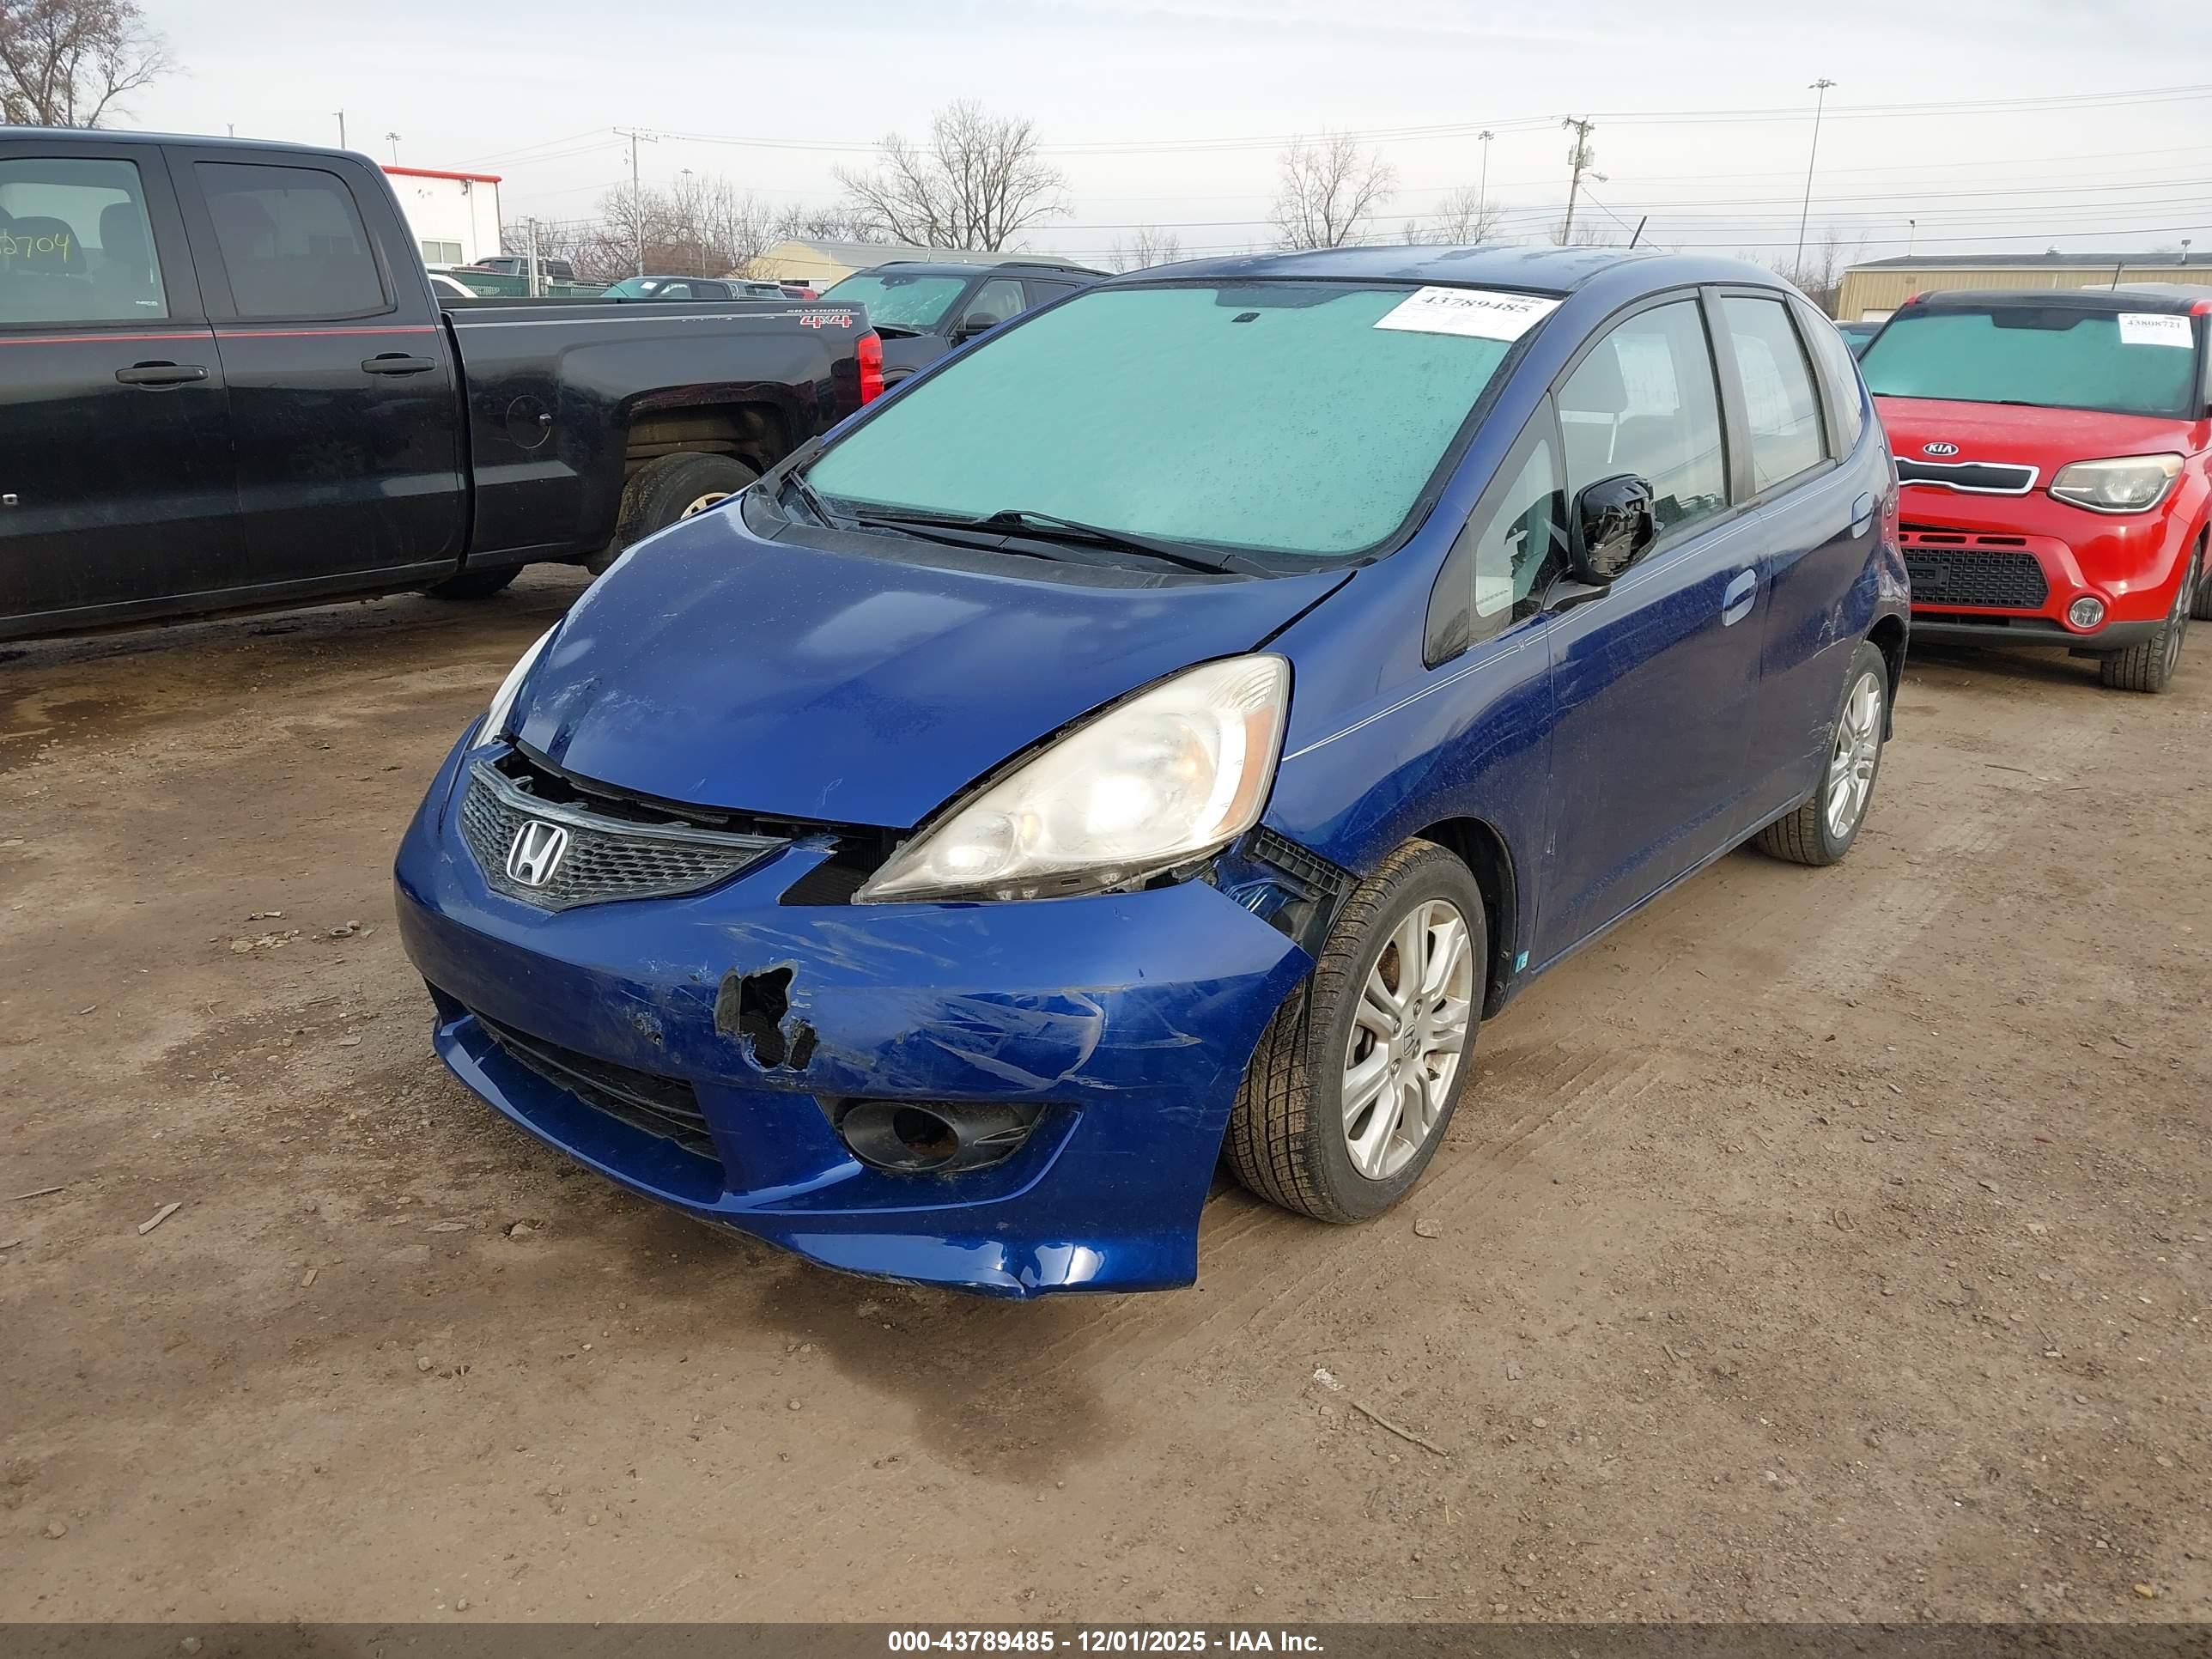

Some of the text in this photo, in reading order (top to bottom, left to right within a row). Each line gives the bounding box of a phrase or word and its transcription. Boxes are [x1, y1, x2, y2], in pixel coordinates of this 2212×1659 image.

[0, 233, 70, 263] 2704
[1421, 295, 1534, 313] 43789485
[1928, 443, 1953, 453] KIA
